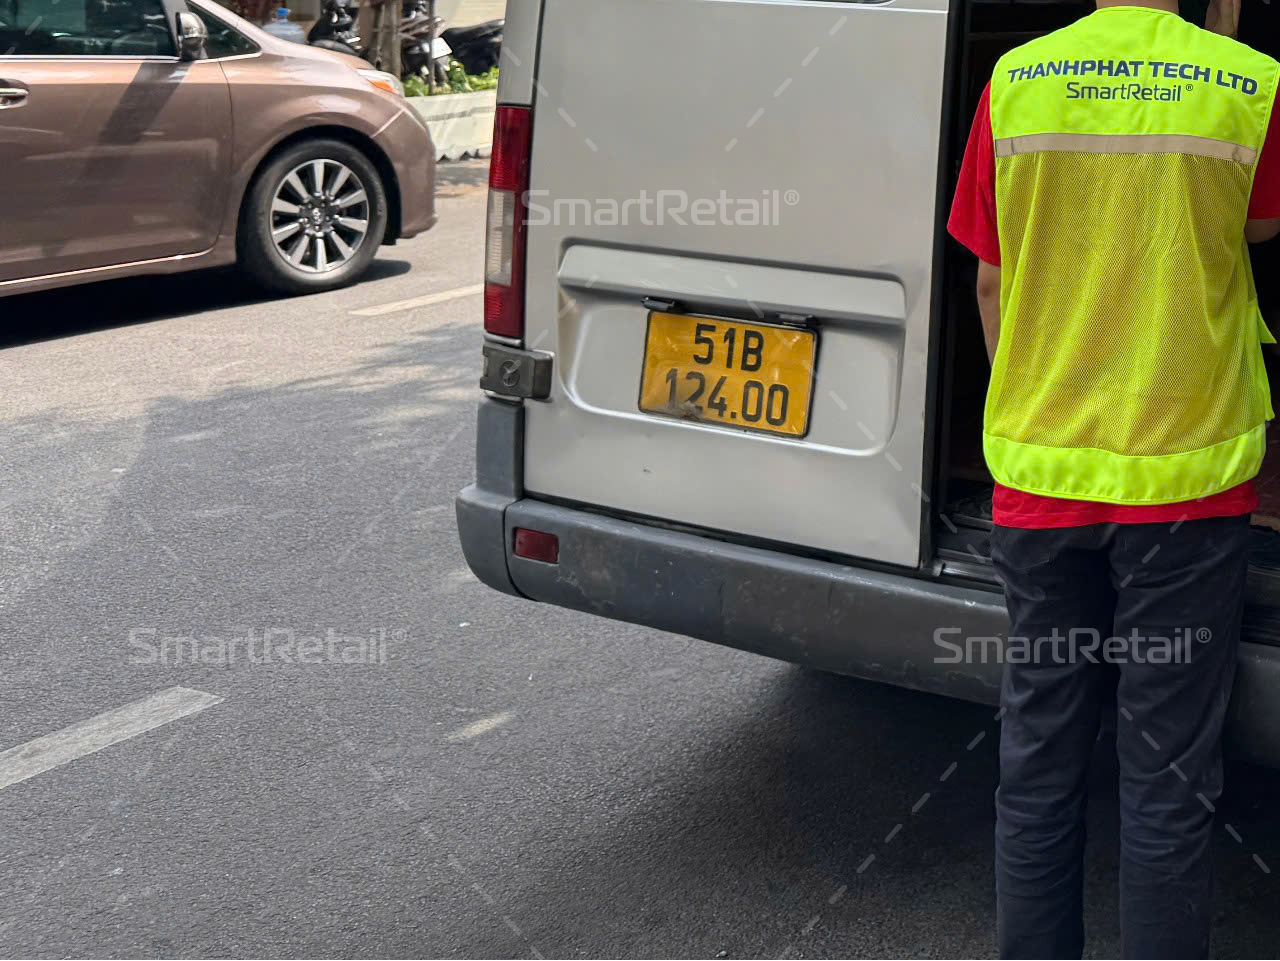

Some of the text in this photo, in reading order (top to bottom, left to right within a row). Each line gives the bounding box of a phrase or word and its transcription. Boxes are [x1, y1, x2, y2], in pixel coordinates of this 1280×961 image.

[1008, 59, 1258, 96] THANHPHAT TECH LTD
[693, 322, 765, 372] 51B
[665, 367, 790, 427] 124.00
